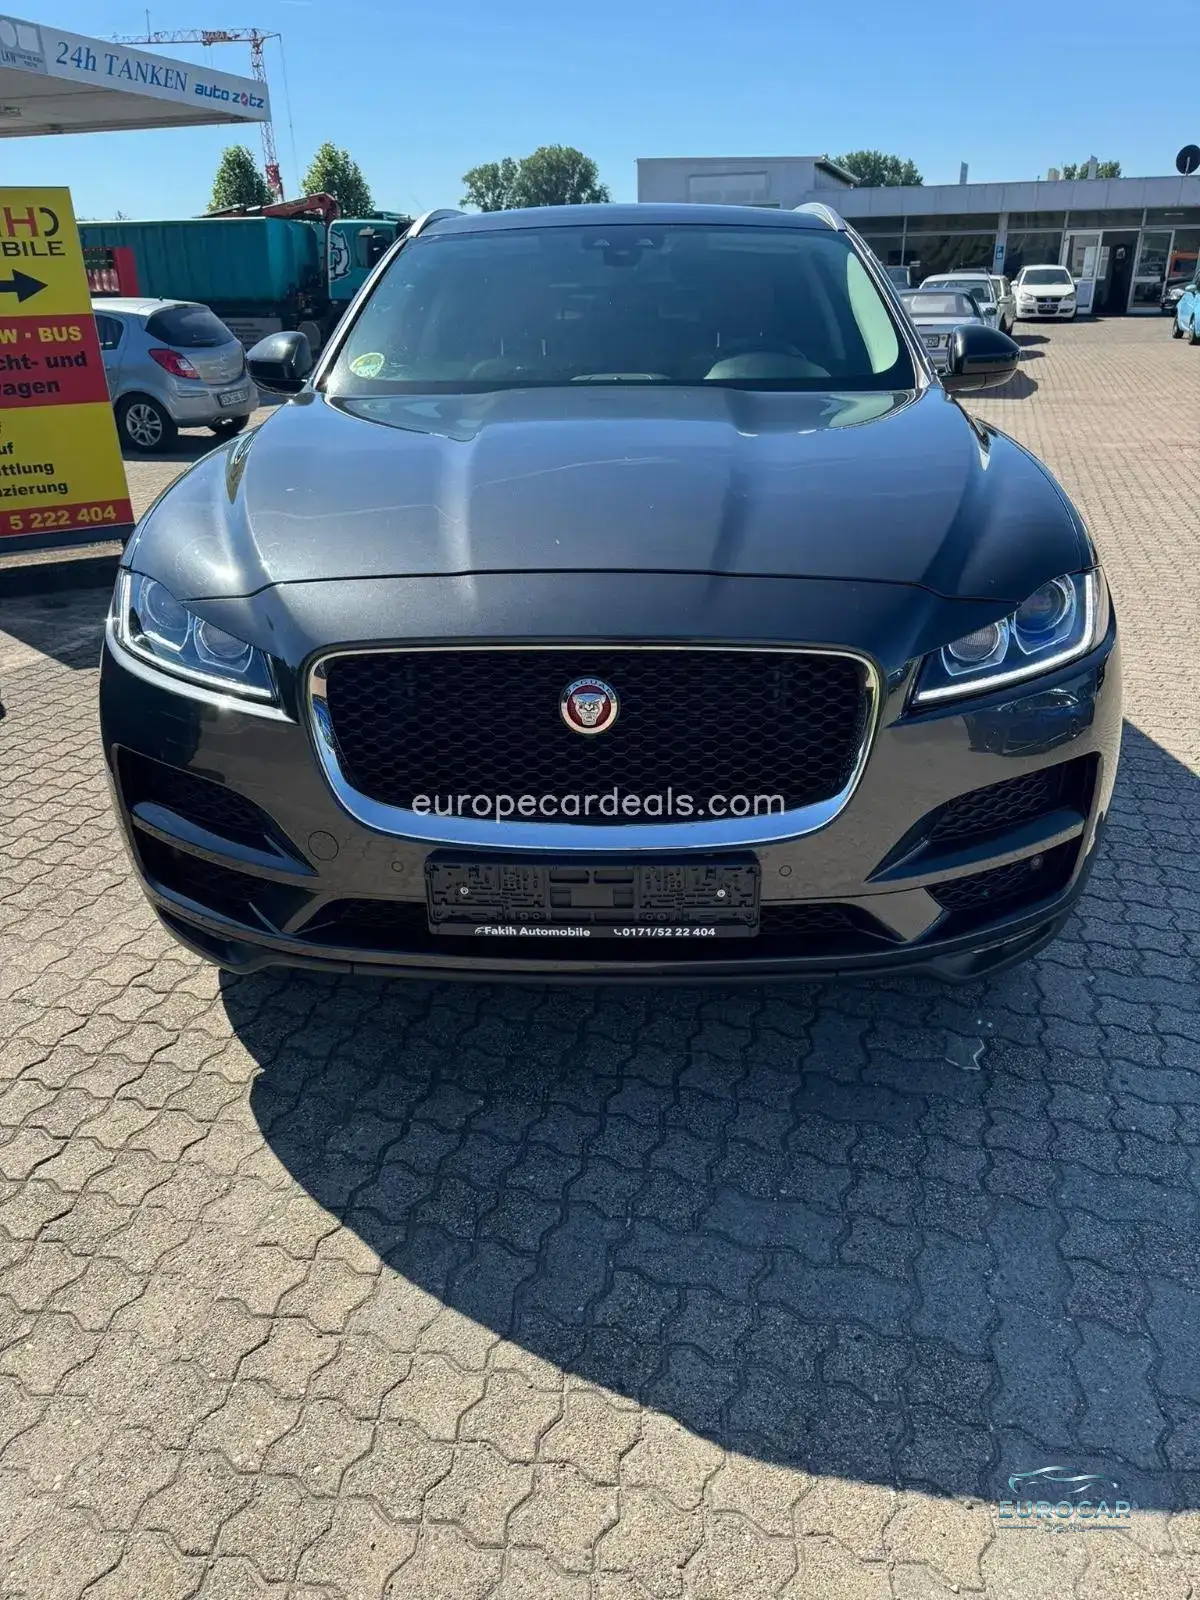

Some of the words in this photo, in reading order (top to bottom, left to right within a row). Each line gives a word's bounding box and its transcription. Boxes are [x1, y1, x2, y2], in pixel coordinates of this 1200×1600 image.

[56, 41, 97, 72] 24h
[104, 52, 189, 92] TANKEN
[194, 83, 230, 101] auto
[1, 240, 67, 256] BILE
[38, 326, 82, 343] BUS
[45, 350, 87, 368] und
[0, 380, 61, 398] agen
[9, 515, 24, 530] 5
[29, 510, 72, 529] 222
[77, 505, 117, 522] 404
[484, 926, 517, 936] Fakih
[519, 926, 591, 937] Automobile
[622, 927, 672, 937] 0171/52
[674, 927, 690, 937] 22
[692, 927, 716, 937] 404
